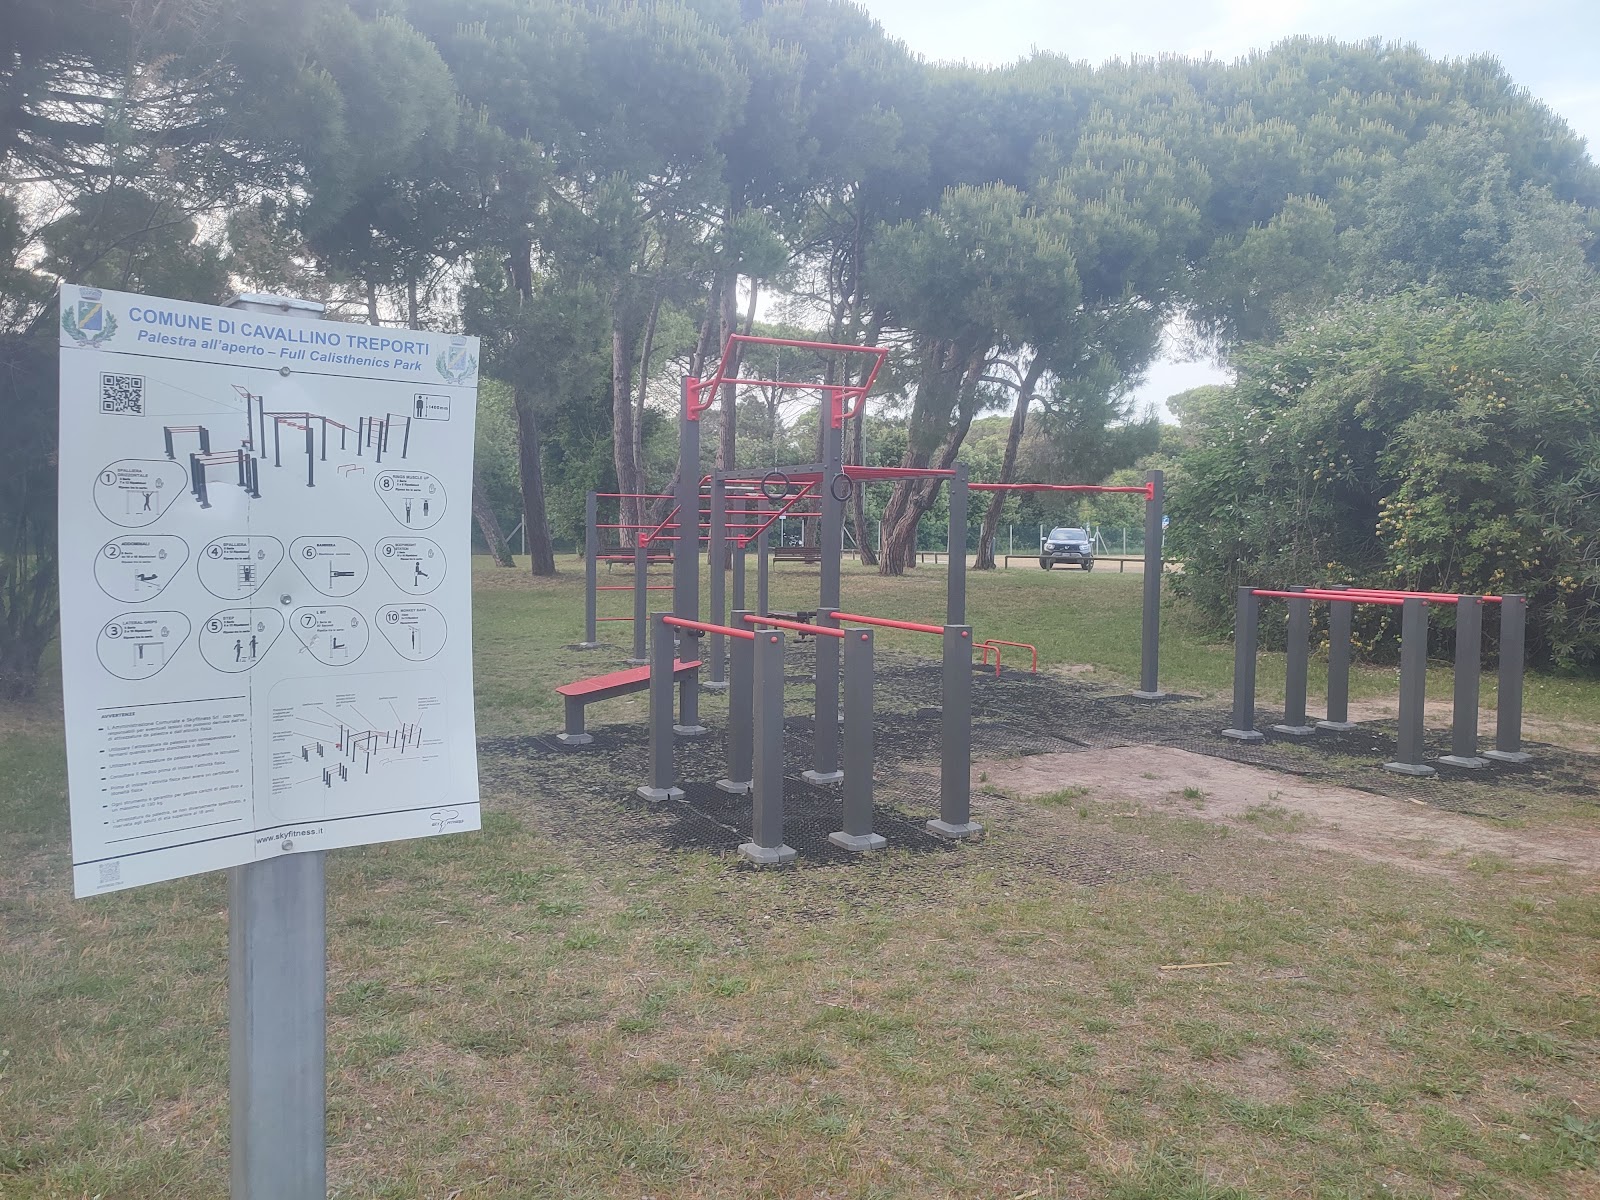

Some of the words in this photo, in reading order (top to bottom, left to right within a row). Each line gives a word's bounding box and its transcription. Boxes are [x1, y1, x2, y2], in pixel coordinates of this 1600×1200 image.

[129, 307, 212, 331] COMUNE
[218, 319, 235, 334] DI
[240, 322, 341, 346] CAVALLINO
[346, 334, 429, 356] TREPORTI
[137, 329, 197, 347] Palestra
[279, 347, 306, 360] Full
[309, 350, 390, 368] Calisthenics
[393, 358, 422, 371] Park
[106, 473, 111, 483] 1
[383, 478, 390, 488] 8
[109, 546, 116, 556] 2
[211, 547, 219, 556] 4
[306, 548, 313, 557] 6
[386, 546, 392, 555] 9
[305, 616, 312, 626] 7
[387, 613, 398, 621] 10
[110, 626, 118, 636] 3
[211, 621, 218, 631] 5
[256, 827, 323, 844] www.skyfitness.it
